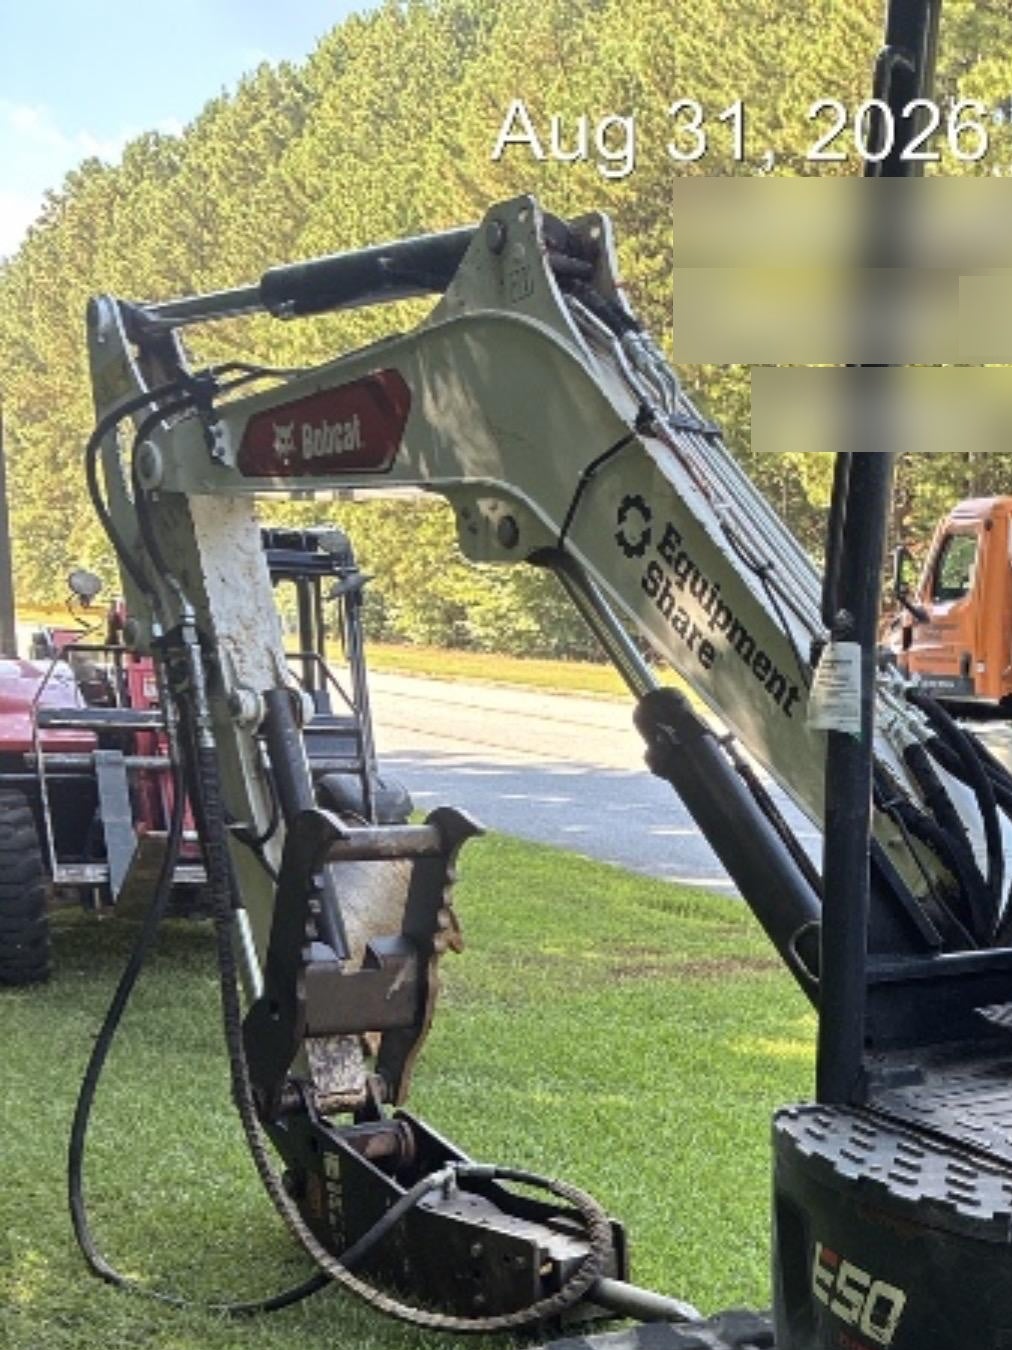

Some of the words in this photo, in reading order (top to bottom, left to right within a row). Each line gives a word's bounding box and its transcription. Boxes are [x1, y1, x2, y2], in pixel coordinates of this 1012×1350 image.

[301, 413, 363, 459] Bobcat
[641, 560, 717, 670] Share
[656, 521, 801, 718] Equipment
[812, 1241, 907, 1346] E50
